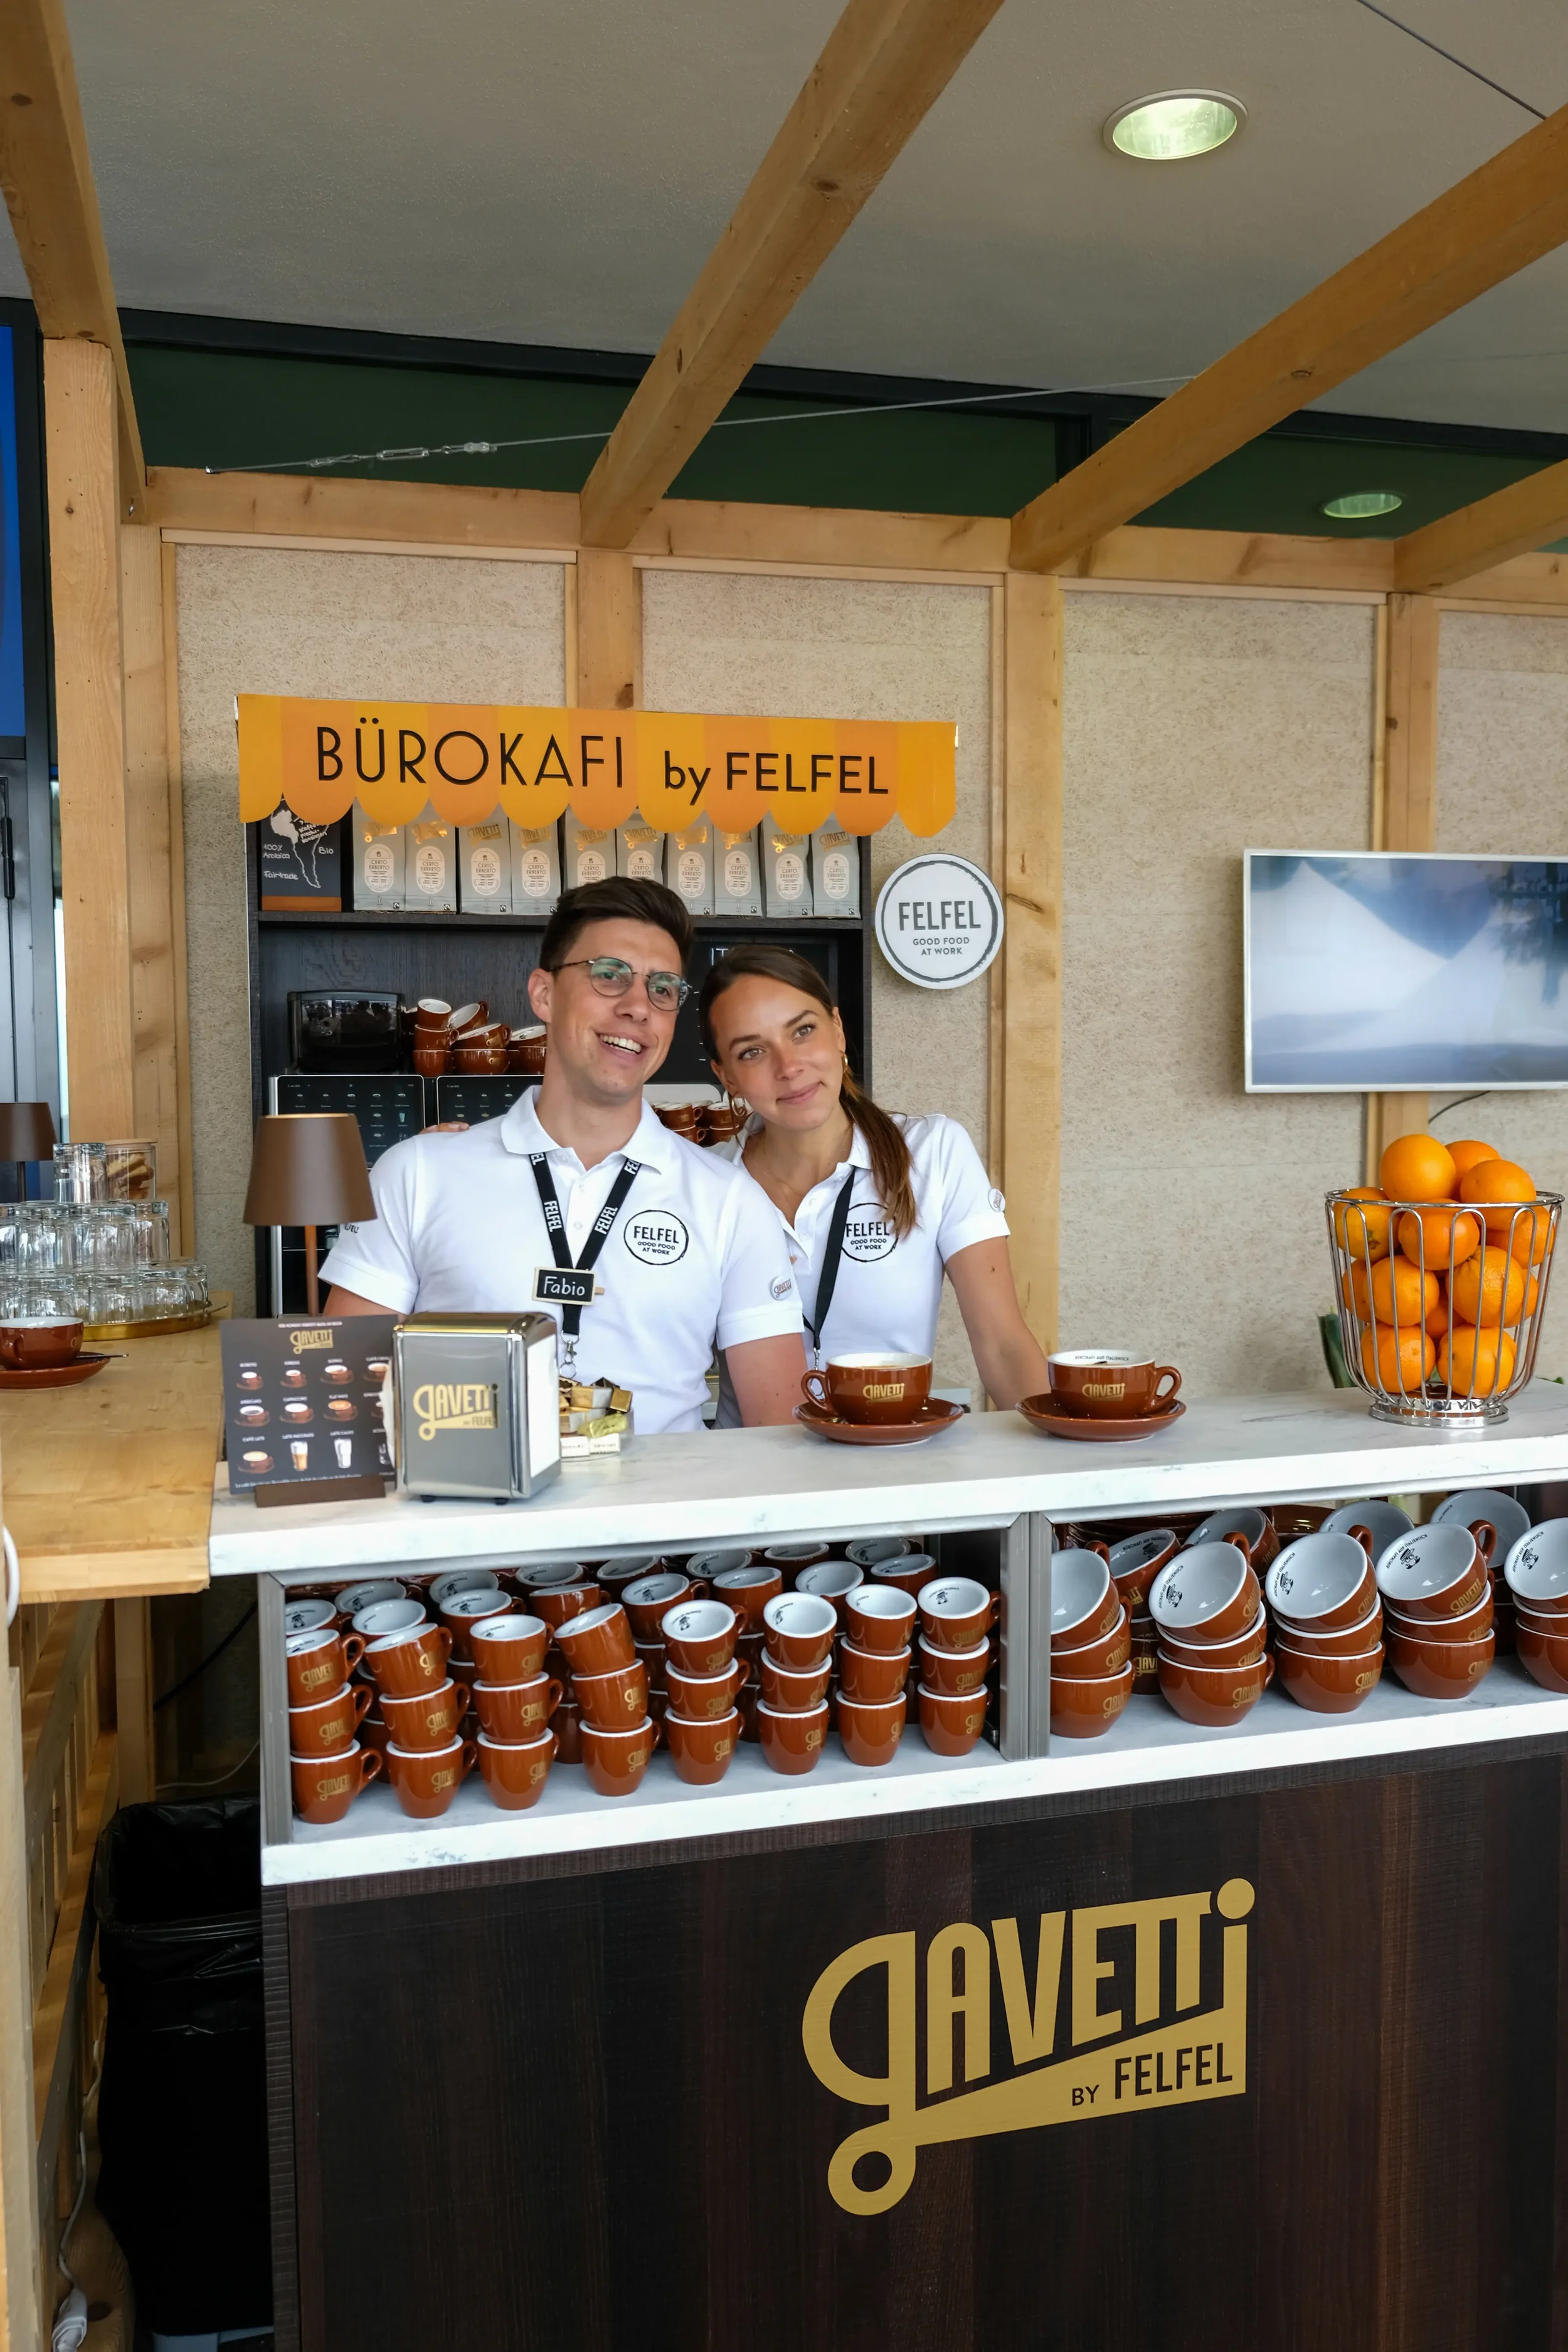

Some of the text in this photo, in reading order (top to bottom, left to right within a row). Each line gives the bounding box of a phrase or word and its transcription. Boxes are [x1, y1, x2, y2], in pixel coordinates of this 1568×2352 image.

[317, 717, 889, 806] BÜROKAFI by FELFEL
[263, 844, 283, 852] 100%
[898, 901, 982, 931] FELFEL
[544, 1200, 563, 1232] FELFEL
[594, 1206, 618, 1235] FELFEL
[845, 1221, 890, 1238] FELFEL
[633, 1226, 679, 1244] FELFEL
[543, 1275, 585, 1296] Fabio
[1071, 2042, 1233, 2107] BY FELFEL
